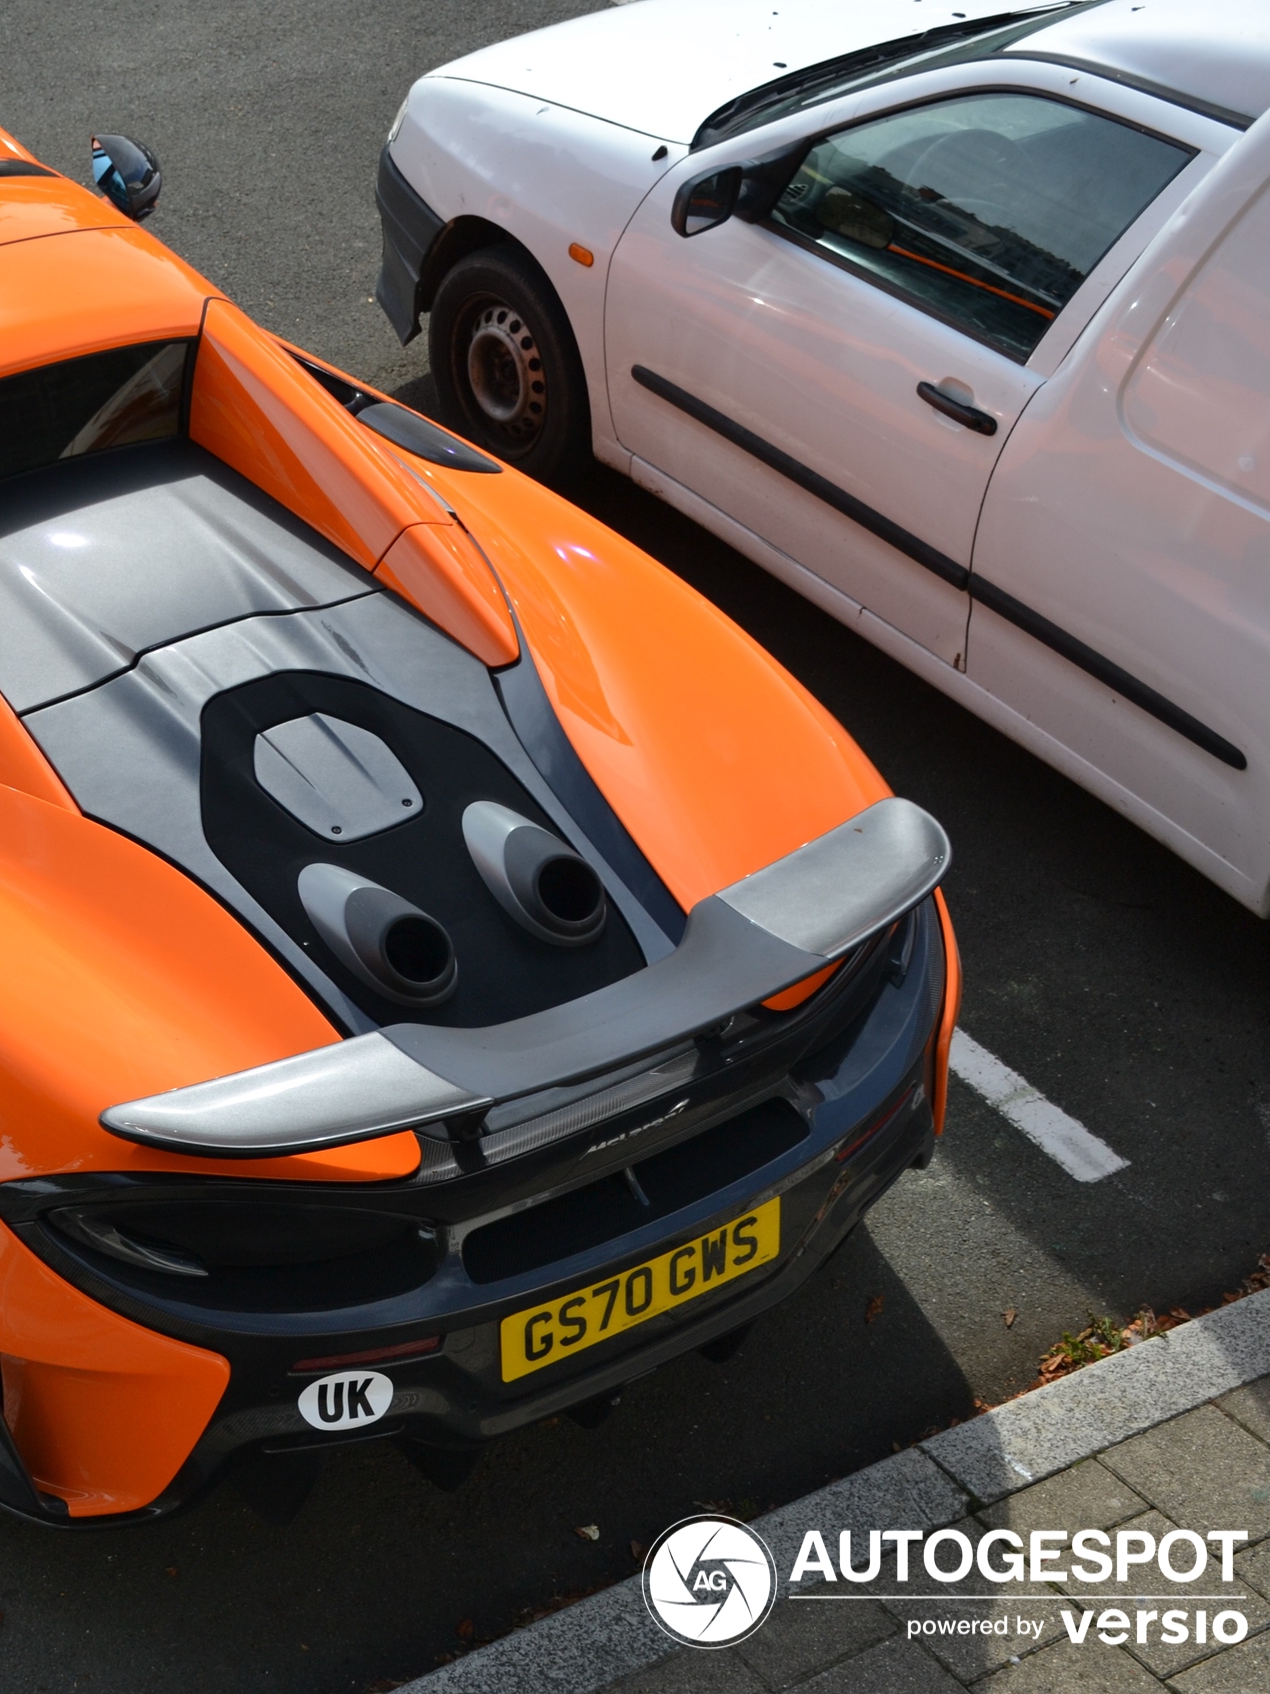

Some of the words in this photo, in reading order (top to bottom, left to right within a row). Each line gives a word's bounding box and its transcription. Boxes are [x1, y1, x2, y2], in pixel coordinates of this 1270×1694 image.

[525, 1267, 653, 1362] GS70
[670, 1217, 758, 1296] GWS
[317, 1377, 376, 1424] UK
